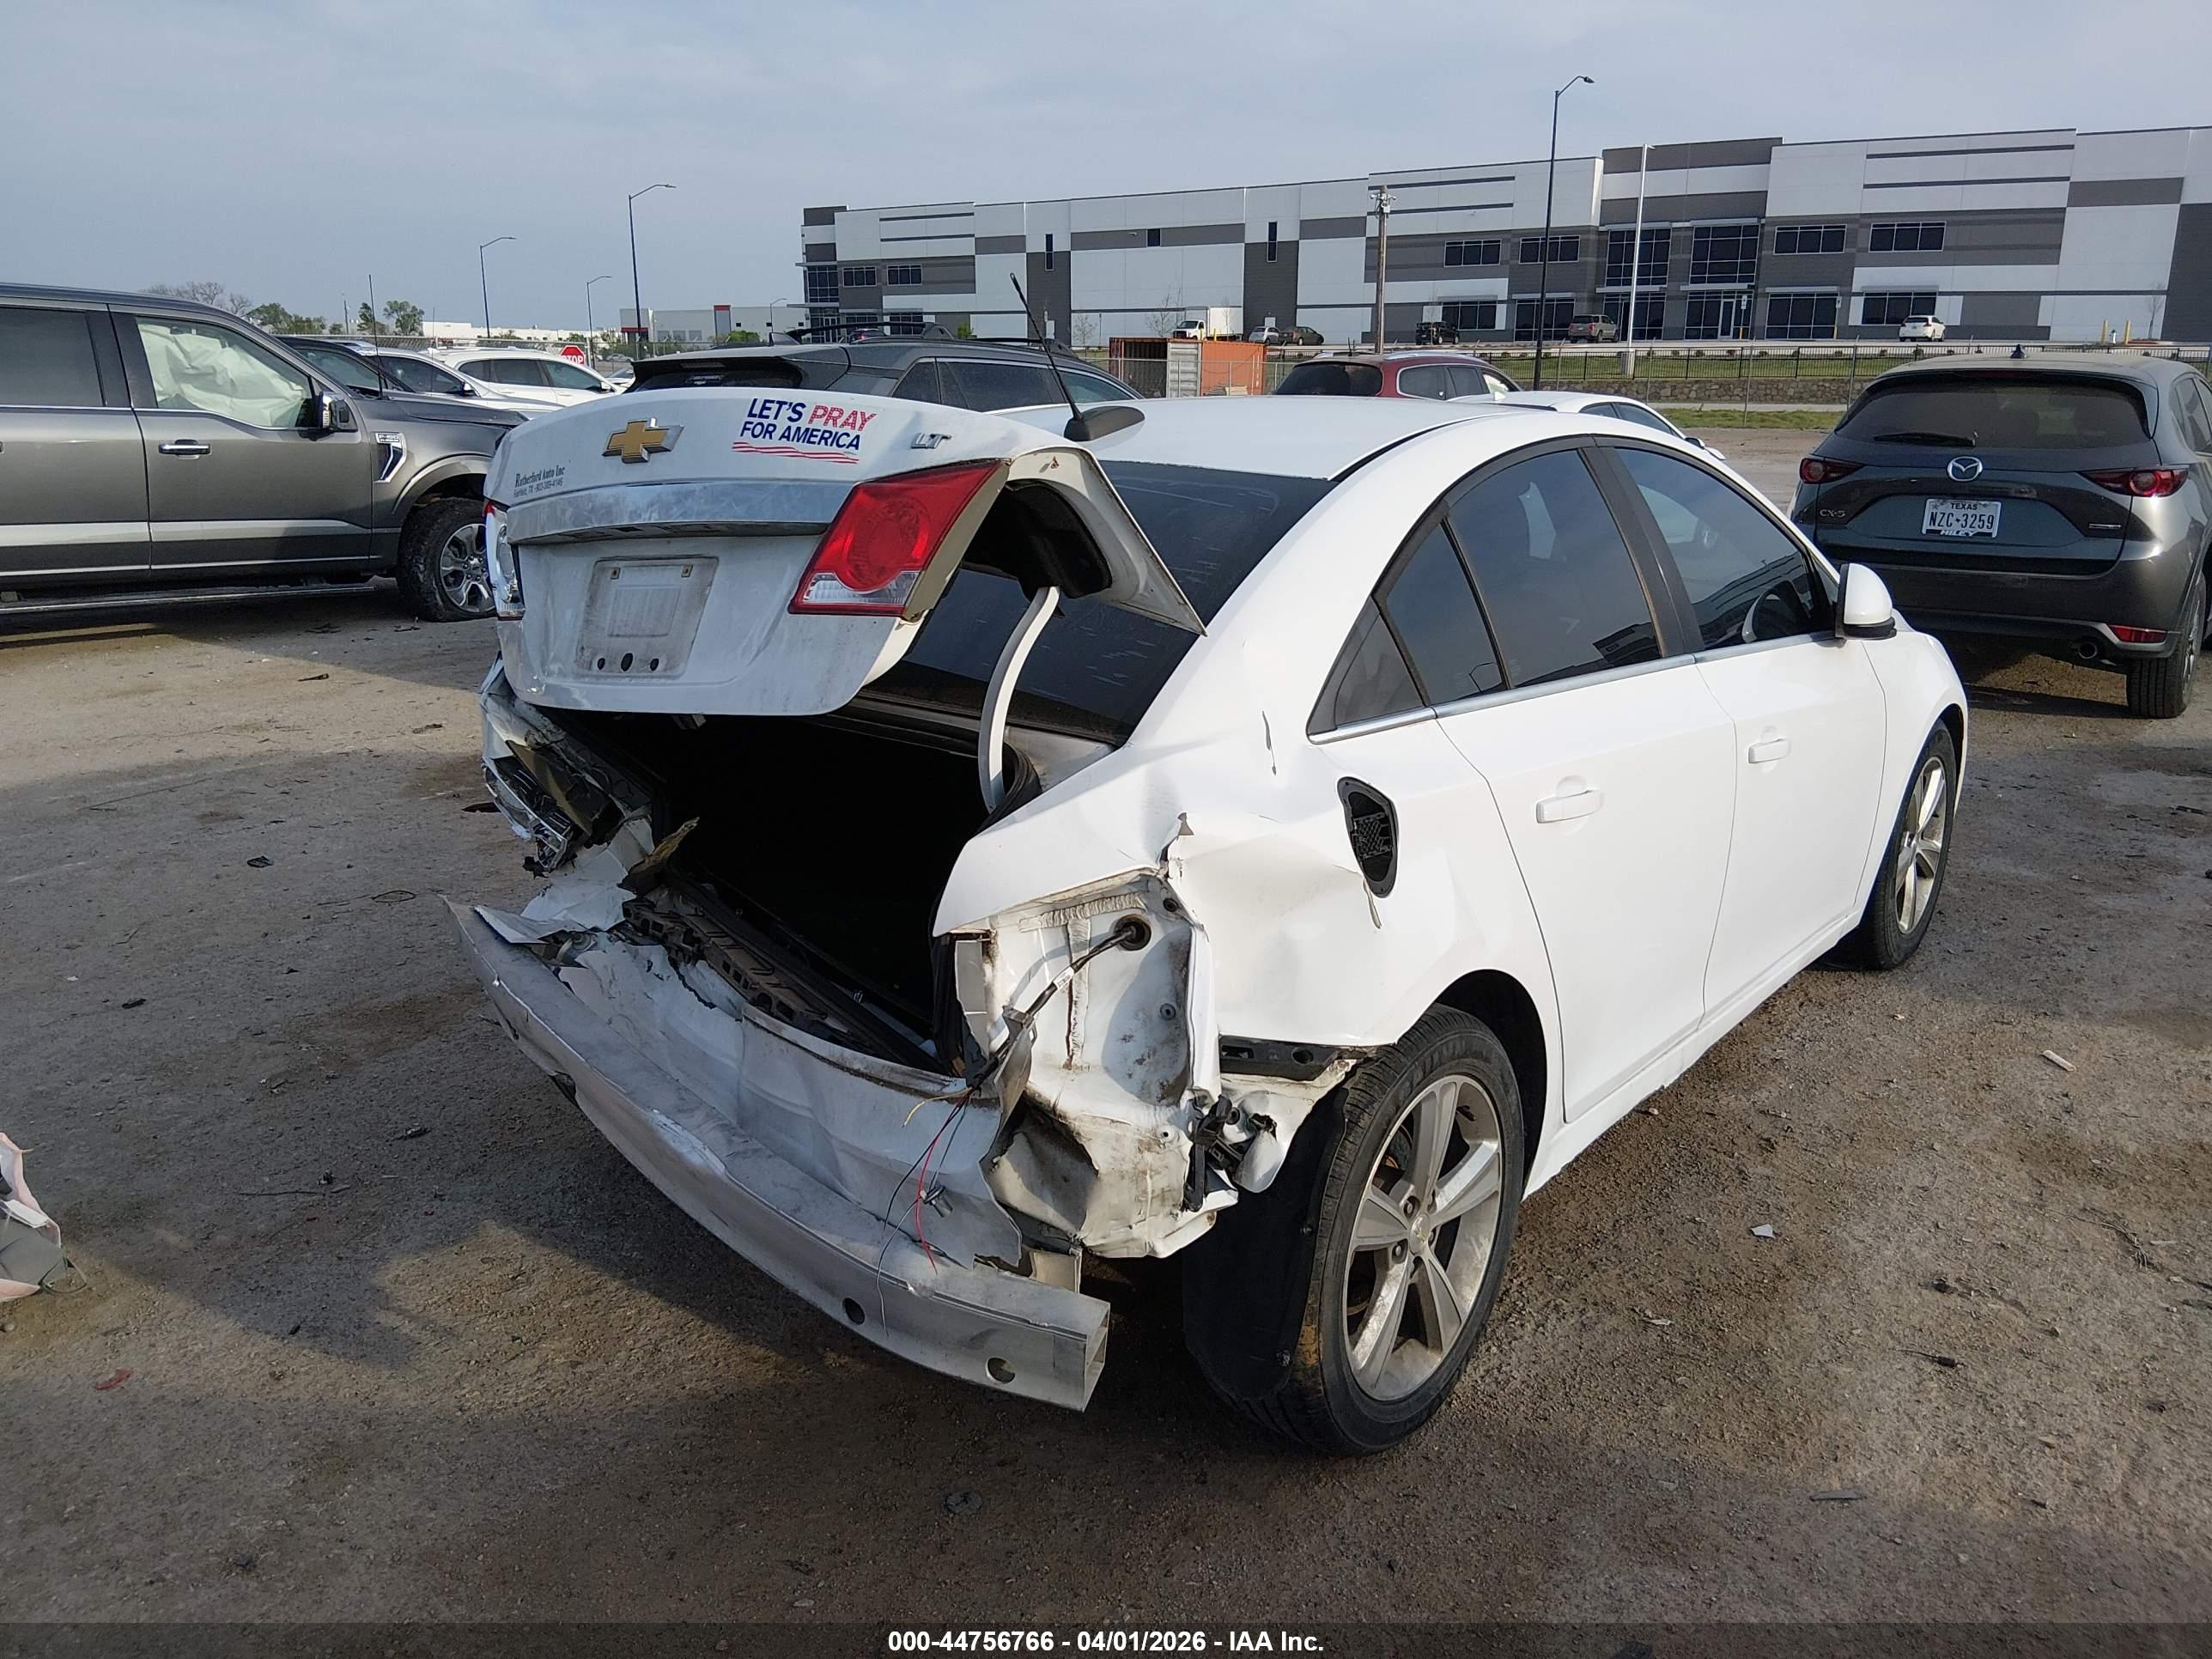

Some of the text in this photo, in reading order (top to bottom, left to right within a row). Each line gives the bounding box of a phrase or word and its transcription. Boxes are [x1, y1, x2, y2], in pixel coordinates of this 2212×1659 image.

[747, 398, 877, 431] LET'S PRAY
[740, 421, 861, 451] FOR AMERICA
[910, 432, 951, 449] LT
[542, 468, 555, 481] Auto
[1820, 508, 1845, 518] CX-5
